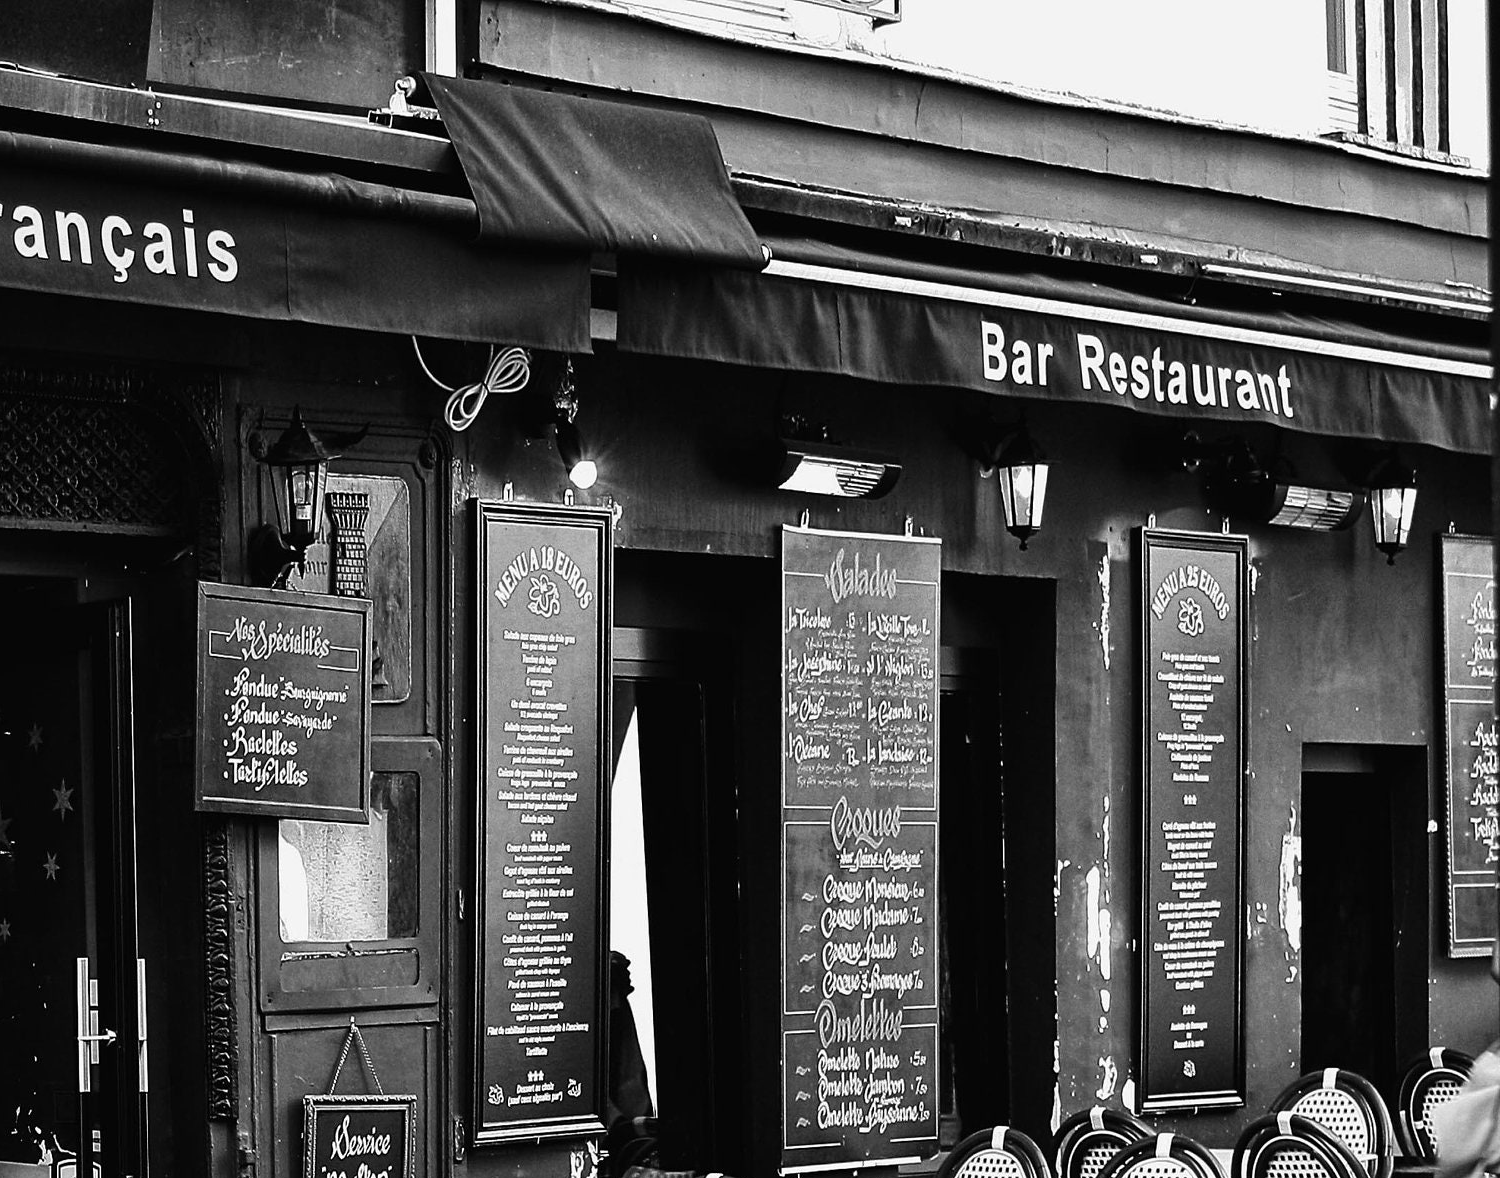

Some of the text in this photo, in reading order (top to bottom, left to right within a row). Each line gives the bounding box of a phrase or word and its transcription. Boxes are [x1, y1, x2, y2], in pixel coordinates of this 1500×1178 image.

[981, 320, 1294, 418] Bar Restaurant
[494, 546, 593, 610] MENU A 18 EUROS
[824, 548, 897, 603] Salades
[1151, 565, 1230, 620] MENU A 25 EUROS
[226, 616, 330, 660] Nos Spécialités
[231, 667, 278, 697] Fondue
[228, 696, 280, 726] Fondue
[226, 726, 298, 756] Raclettes
[228, 757, 308, 791] Tartiflettes
[830, 796, 901, 851] Croques
[823, 874, 864, 903] Croque
[821, 907, 862, 938] Croque
[822, 941, 863, 970] Croque
[822, 970, 860, 999] Croque
[814, 999, 902, 1048] Omelettes
[330, 1114, 391, 1160] Service
